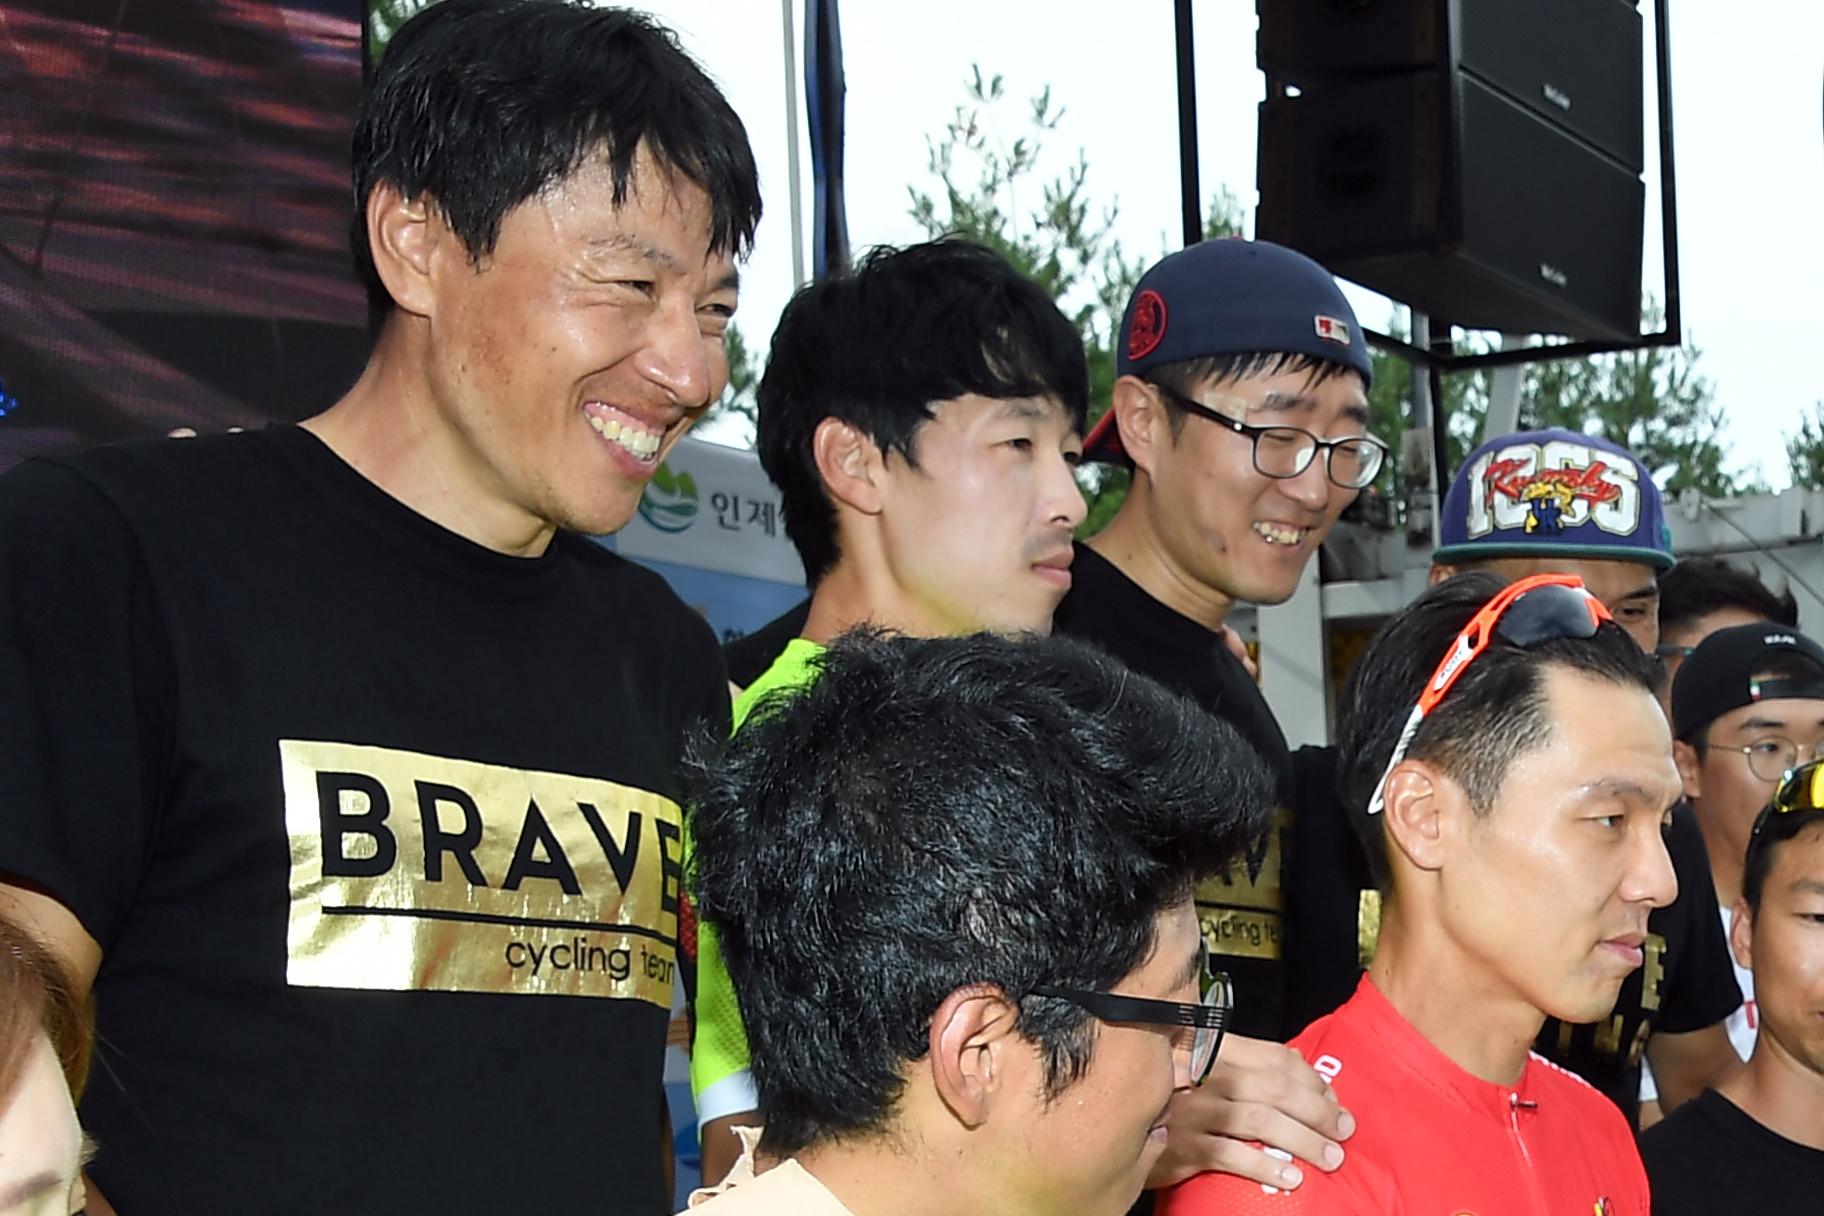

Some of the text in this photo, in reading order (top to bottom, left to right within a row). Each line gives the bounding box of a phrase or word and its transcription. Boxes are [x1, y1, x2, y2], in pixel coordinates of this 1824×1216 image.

[711, 492, 784, 537] 인제
[316, 770, 682, 914] BRAVE
[505, 937, 631, 982] cycling
